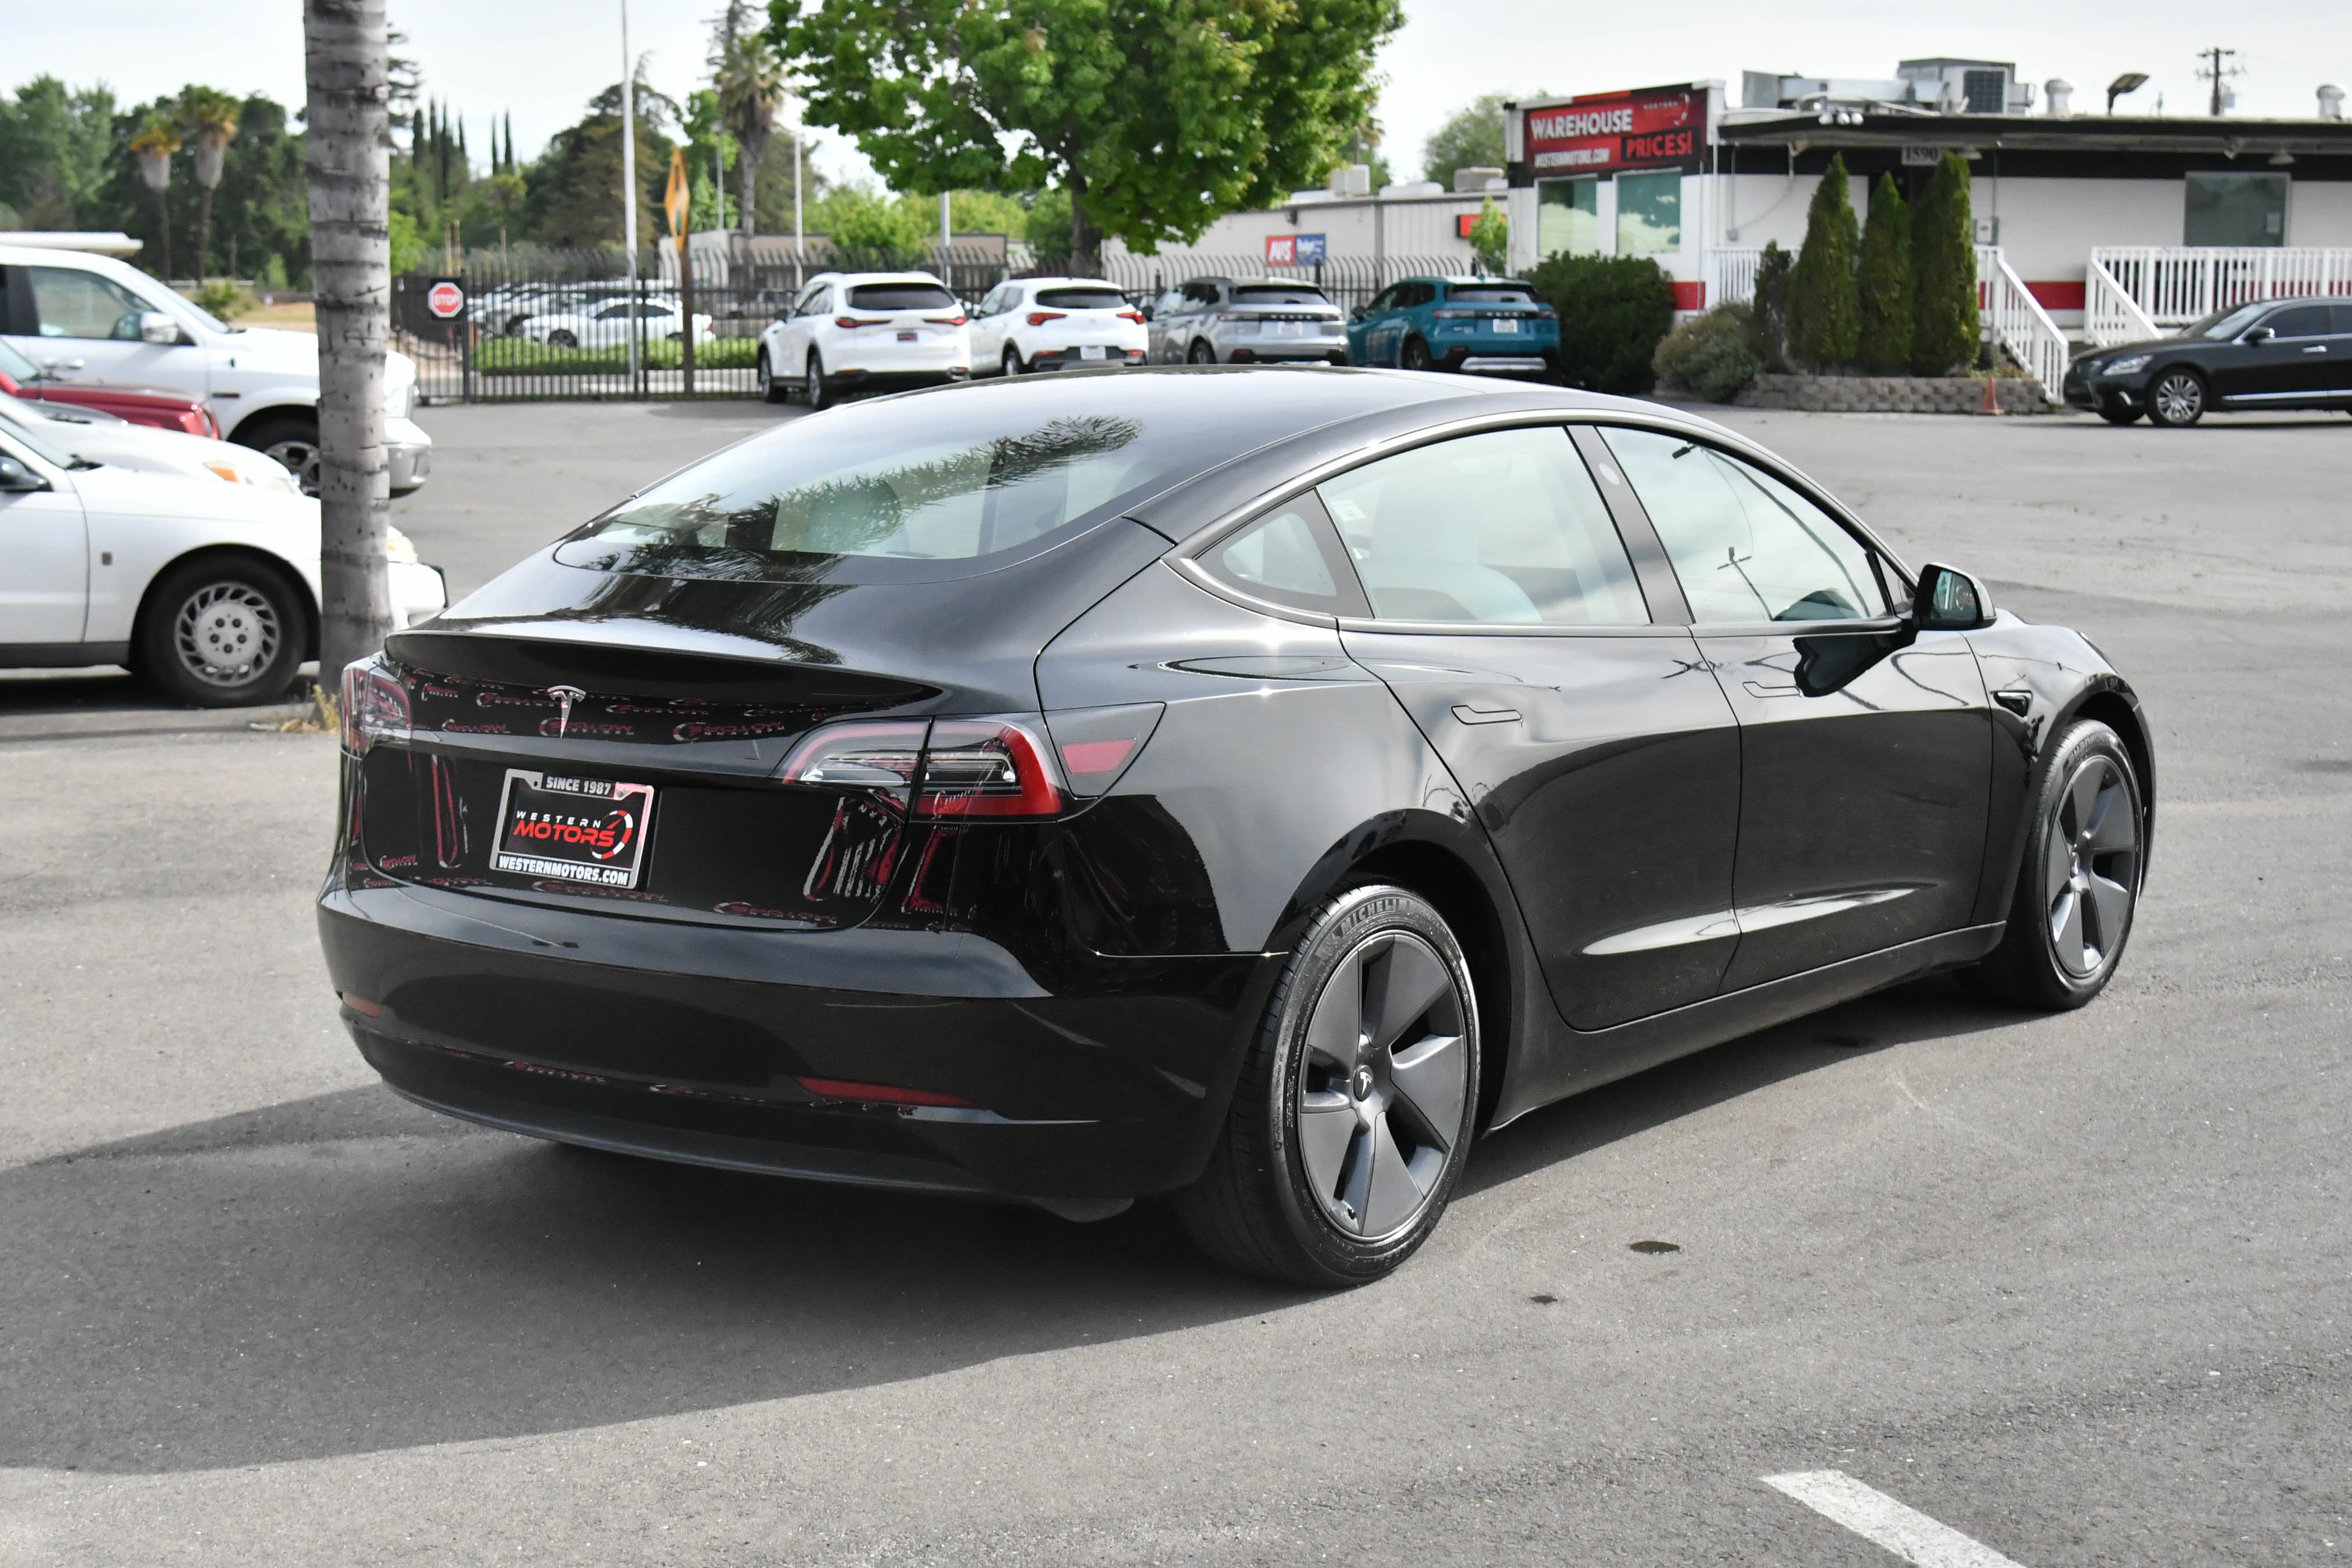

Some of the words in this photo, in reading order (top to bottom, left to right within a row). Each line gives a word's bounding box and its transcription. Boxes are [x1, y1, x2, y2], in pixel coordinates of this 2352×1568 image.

[1530, 108, 1633, 140] WAREHOUSE
[1627, 131, 1692, 158] PRICES!
[546, 776, 579, 791] SINCE
[584, 781, 611, 795] 1987
[516, 810, 601, 828] WESTERN
[513, 820, 615, 847] MOTORS
[499, 856, 628, 885] WESTERNMOTORS.COM
[1341, 899, 1407, 936] MICHELIN
